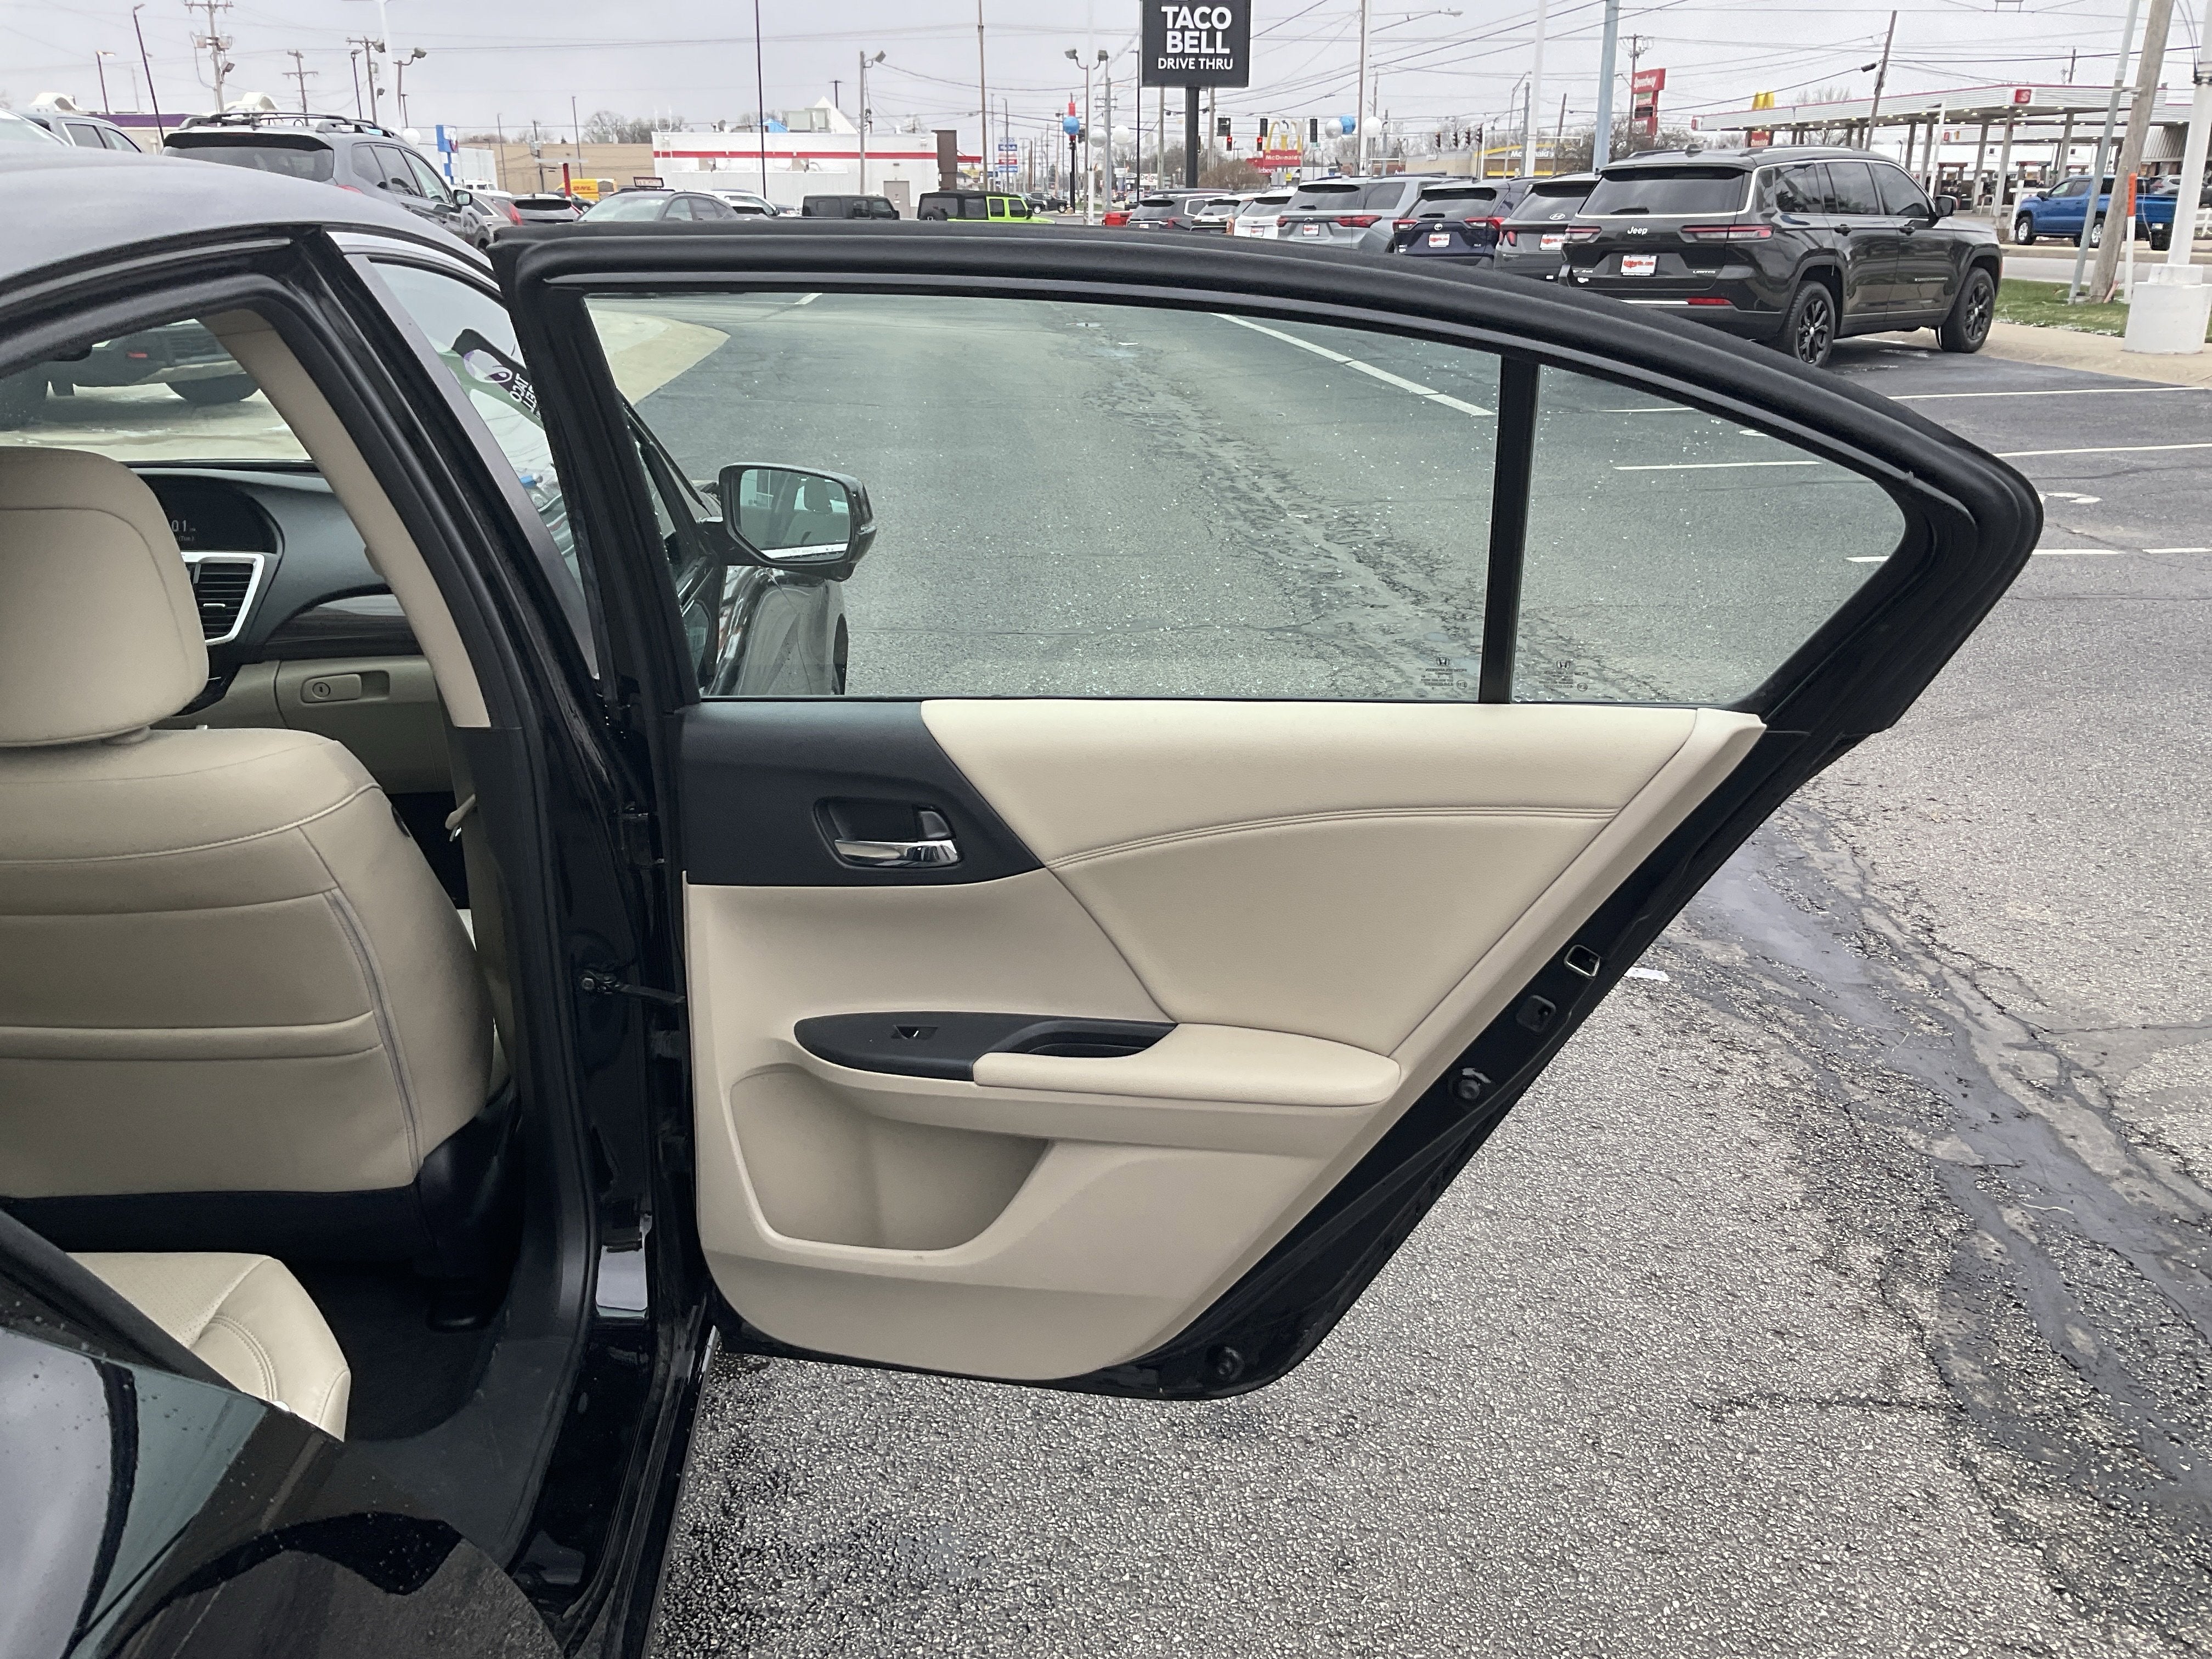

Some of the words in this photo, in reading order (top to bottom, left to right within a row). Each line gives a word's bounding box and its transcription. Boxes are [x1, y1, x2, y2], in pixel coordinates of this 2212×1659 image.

[1161, 6, 1232, 30] TACO
[1166, 31, 1230, 54] BELL
[1158, 58, 1195, 69] DRIVE
[1198, 58, 1233, 70] THRU
[1627, 226, 1648, 236] Jeep
